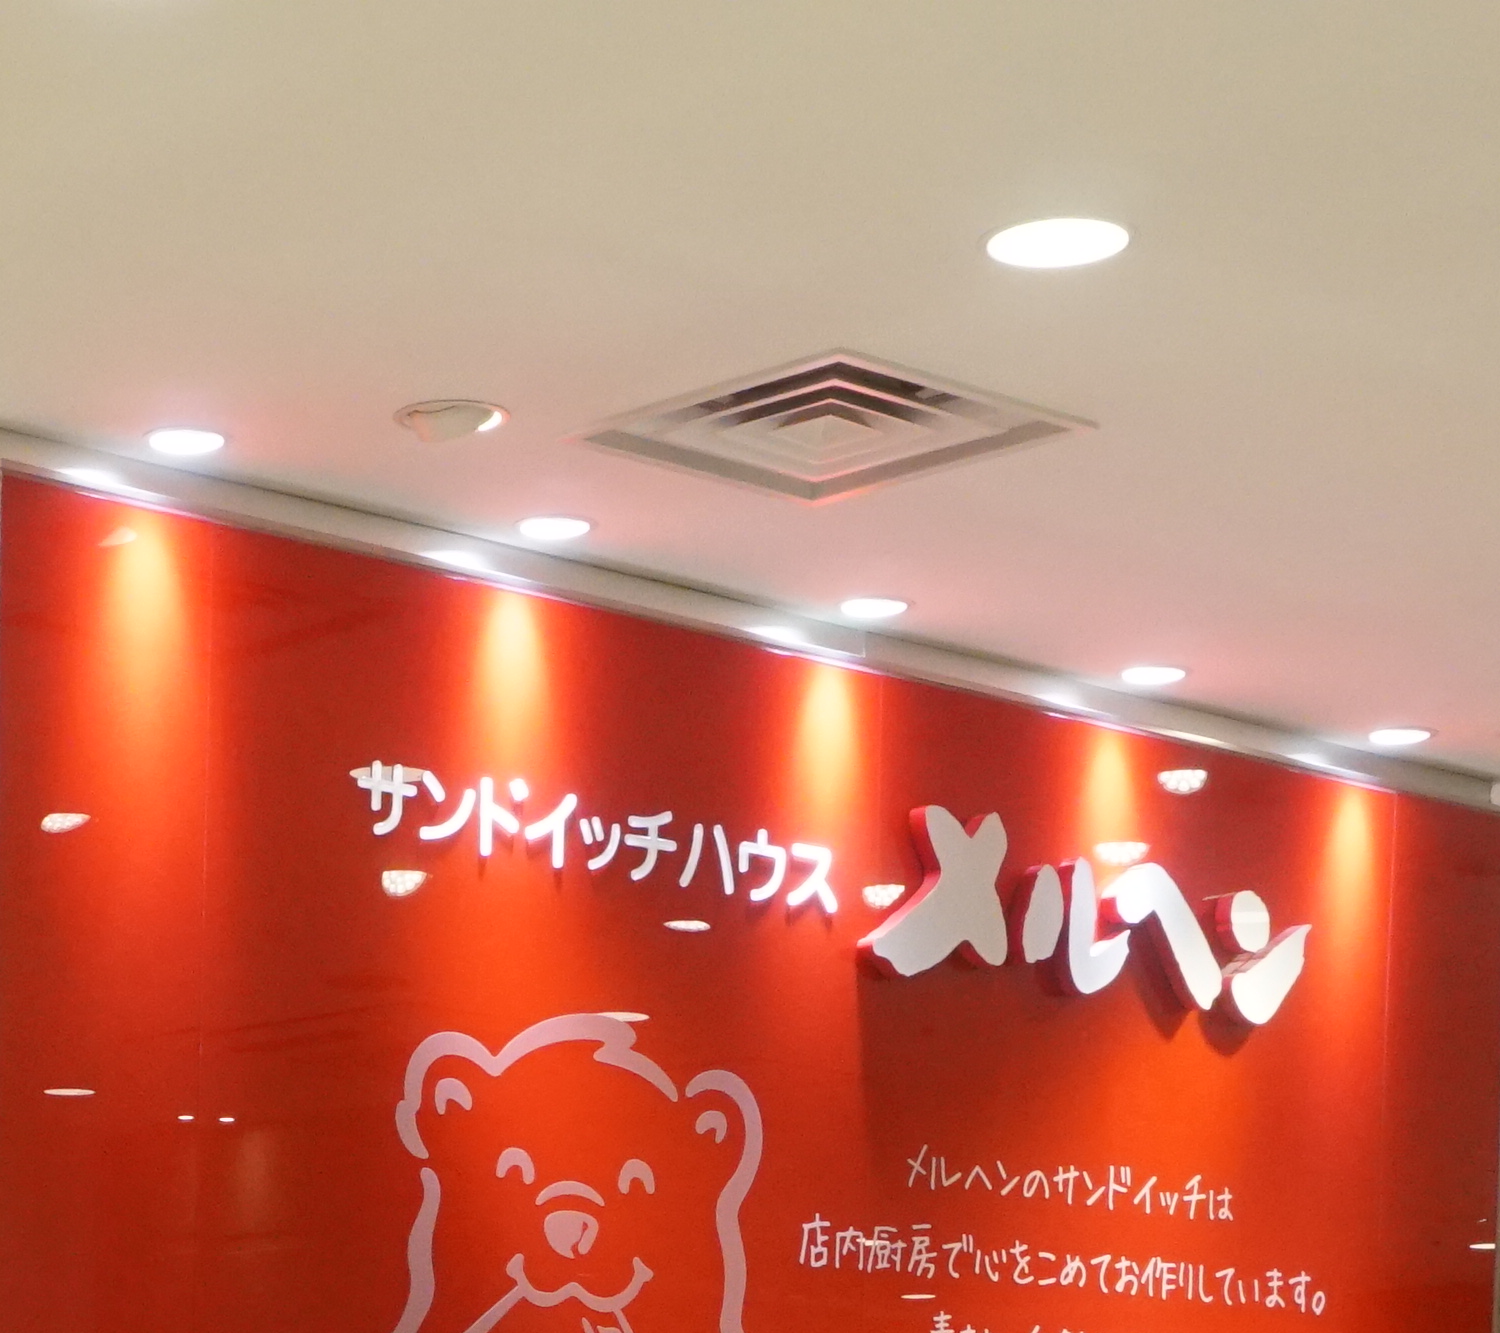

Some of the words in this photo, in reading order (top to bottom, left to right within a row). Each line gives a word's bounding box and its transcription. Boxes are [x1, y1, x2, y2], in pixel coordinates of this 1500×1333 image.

[355, 758, 838, 914] サンドイッチハウス
[855, 804, 1311, 1027] メルヘン
[906, 1144, 1233, 1222] メルヘンのサンドイッチは
[799, 1212, 1326, 1316] 店内厨房で心をこめてお作りしています。
